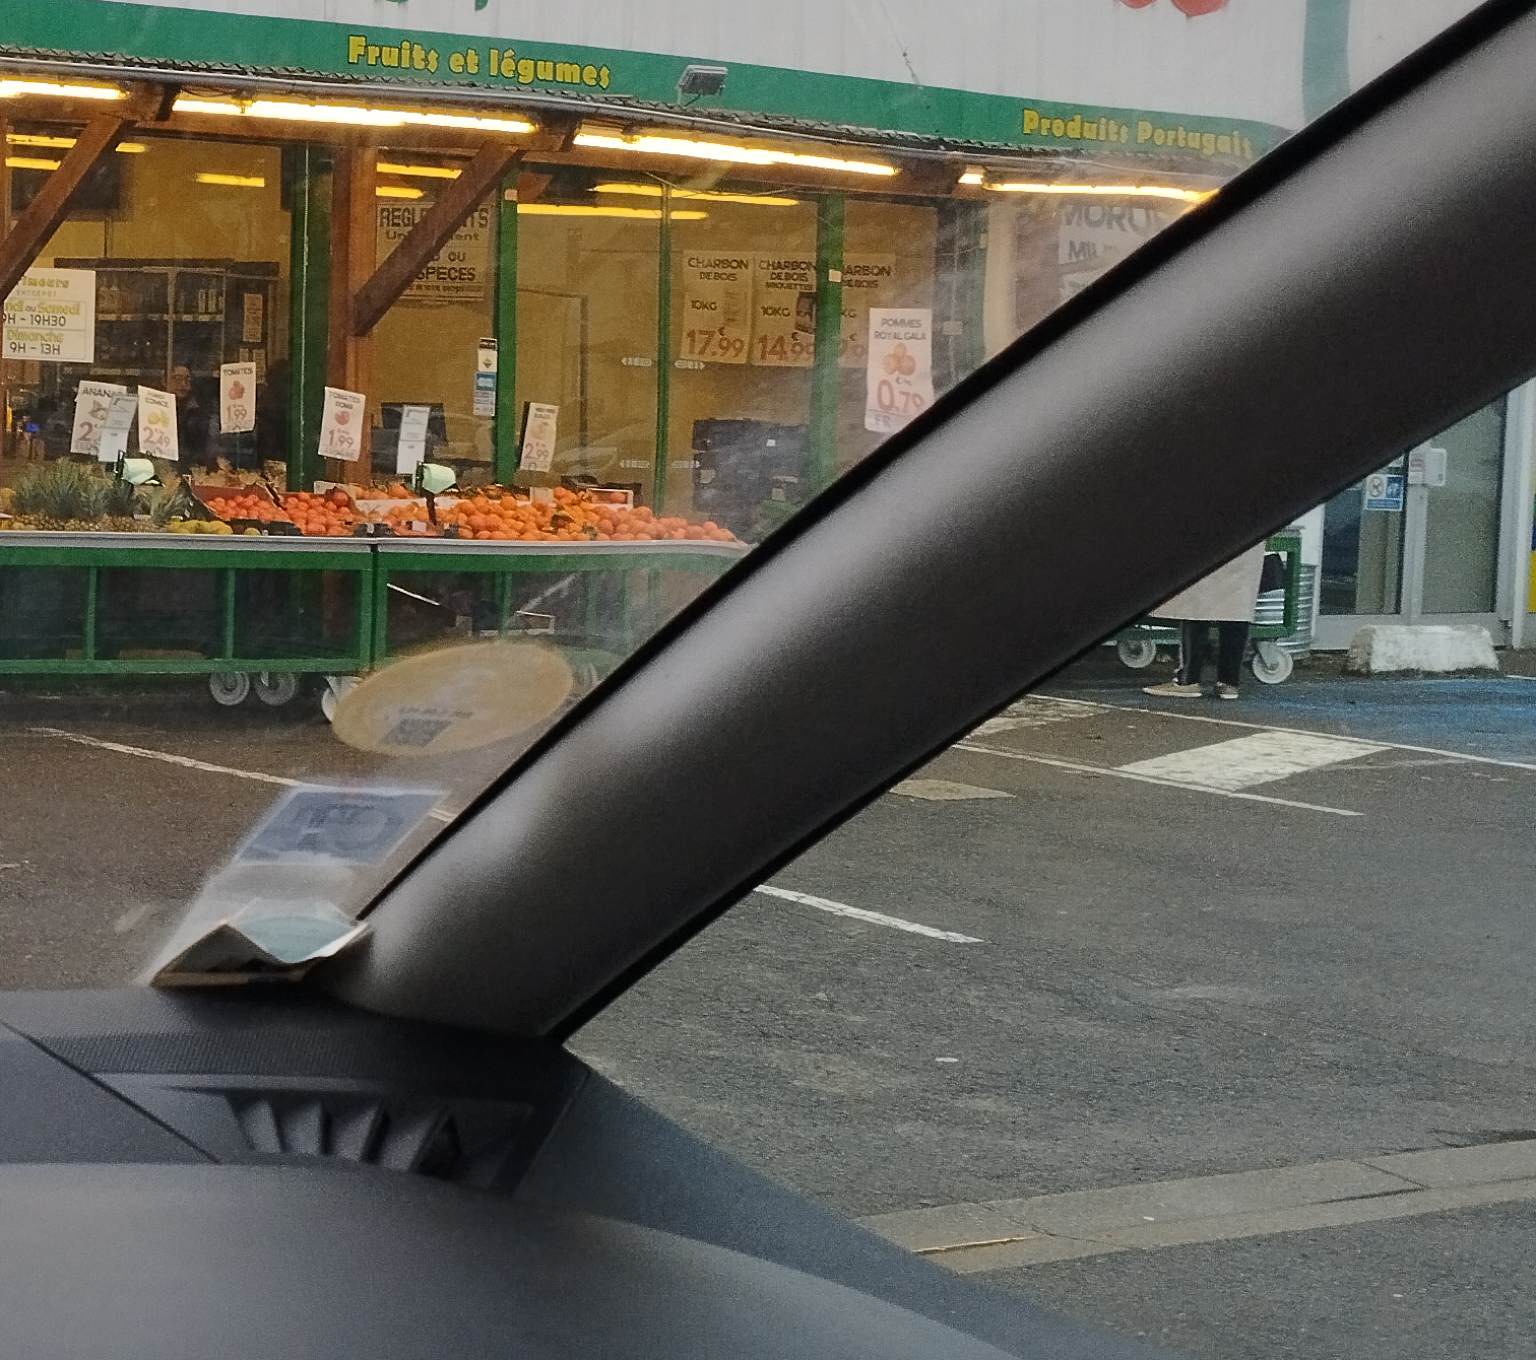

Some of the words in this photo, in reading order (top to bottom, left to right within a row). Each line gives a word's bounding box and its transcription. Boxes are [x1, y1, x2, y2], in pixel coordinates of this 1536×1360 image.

[347, 34, 439, 74] Fruits
[448, 48, 480, 74] et
[489, 48, 611, 89] légumes
[1022, 107, 1130, 144] Produits
[1136, 120, 1254, 161] Portugais
[687, 257, 749, 270] CHARBON
[842, 264, 892, 277] ARBON
[690, 299, 717, 311] 10KG
[760, 305, 791, 317] 10KG
[29, 313, 67, 328] 19H30
[880, 318, 922, 329] POMMES
[9, 341, 27, 354] 9H
[40, 342, 62, 356] 13H
[685, 328, 745, 358] 17.99
[77, 421, 94, 441] 2
